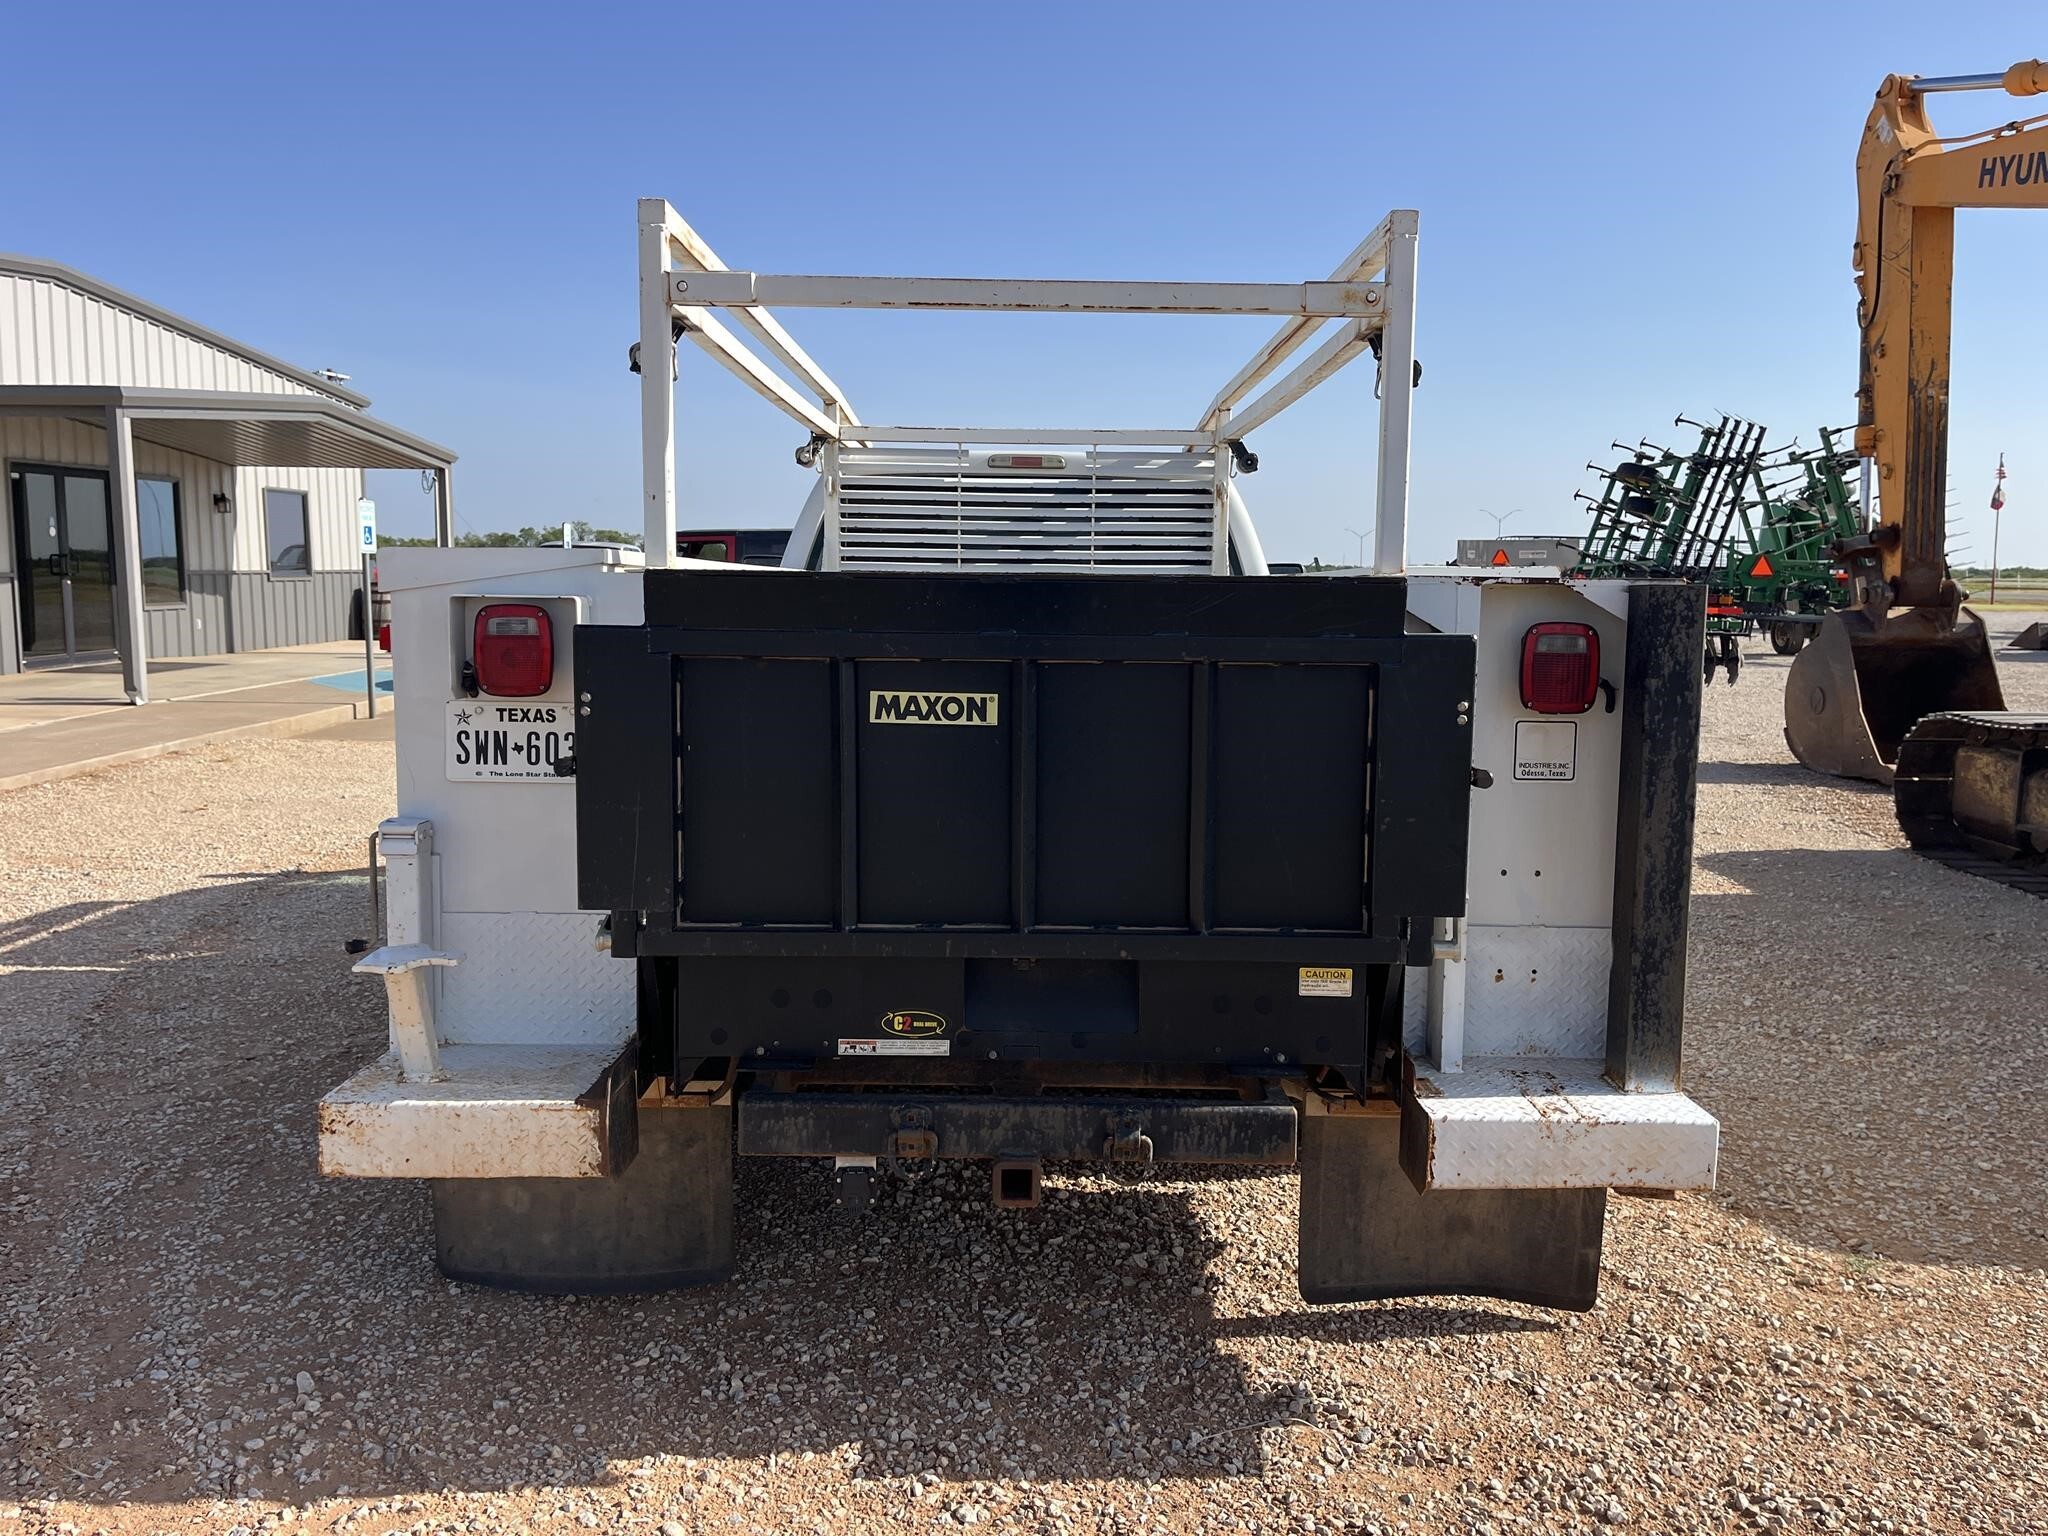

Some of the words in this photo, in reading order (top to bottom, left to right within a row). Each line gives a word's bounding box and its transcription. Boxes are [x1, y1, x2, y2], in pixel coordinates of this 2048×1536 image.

[1978, 151, 2048, 189] HYUN
[496, 707, 557, 723] TEXAS
[874, 694, 988, 722] MAXON
[1521, 769, 1547, 777] Odessa,
[1548, 769, 1567, 777] Texas
[1305, 970, 1347, 979] CAUTION
[893, 1015, 912, 1031] C2
